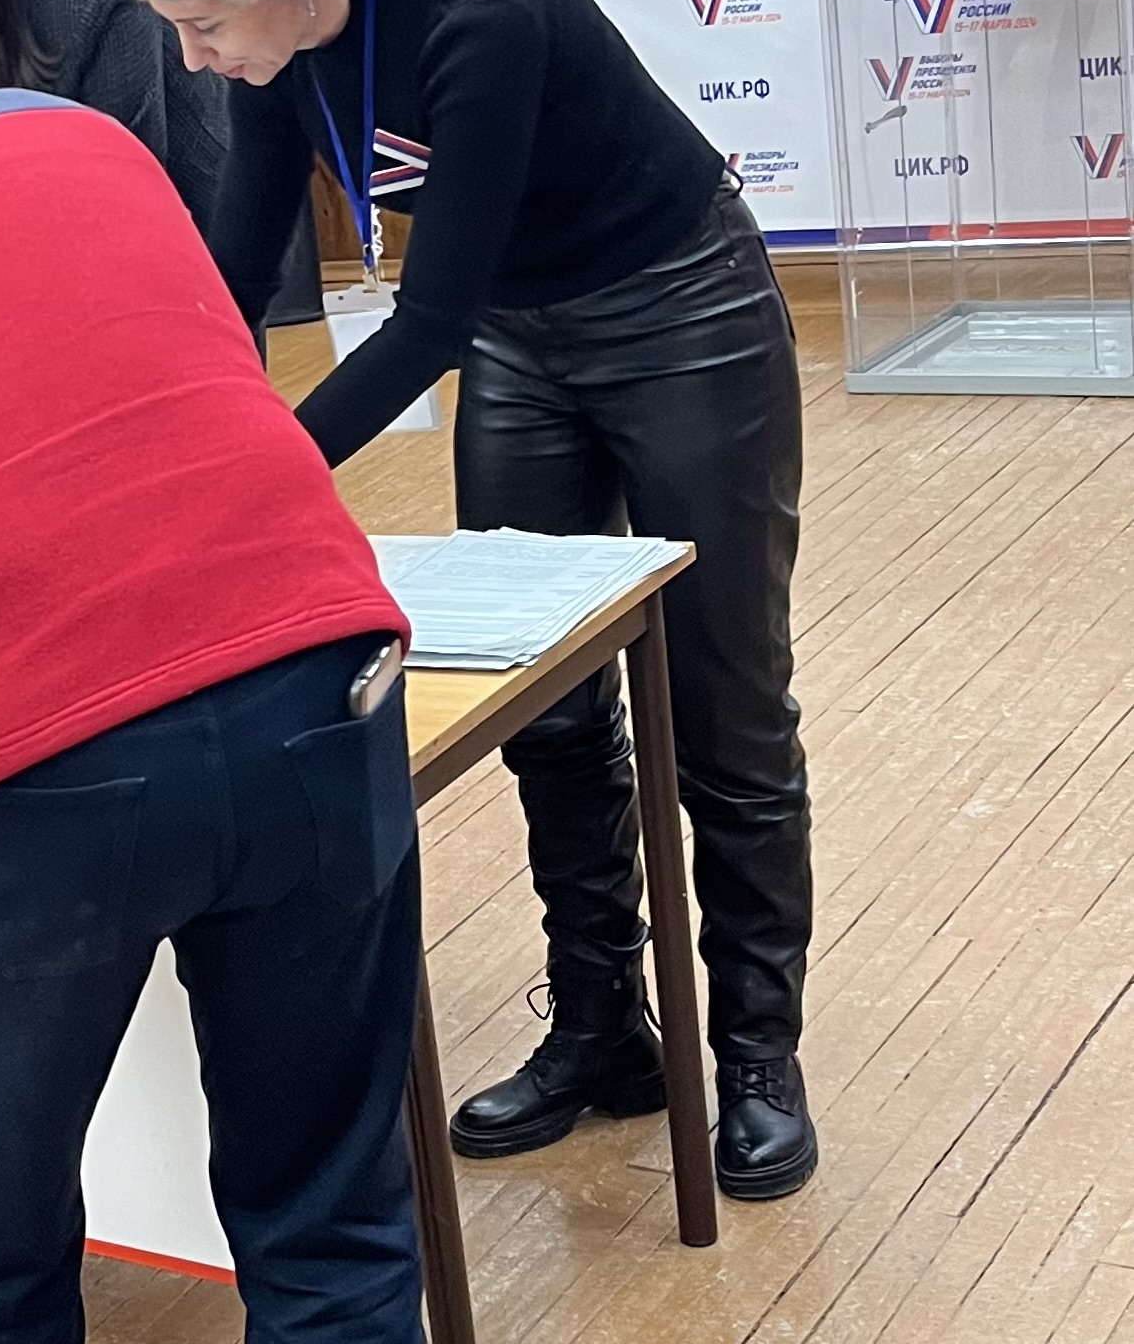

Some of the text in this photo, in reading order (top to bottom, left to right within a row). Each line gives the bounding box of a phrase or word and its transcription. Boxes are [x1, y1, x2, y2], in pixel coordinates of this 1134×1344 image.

[724, 3, 761, 14] РОССИИ
[958, 3, 1011, 18] РОССИИ
[699, 78, 770, 103] ЦИК.РФ
[894, 154, 969, 179] ЦИК.РФ
[743, 175, 774, 184] ОССИИ
